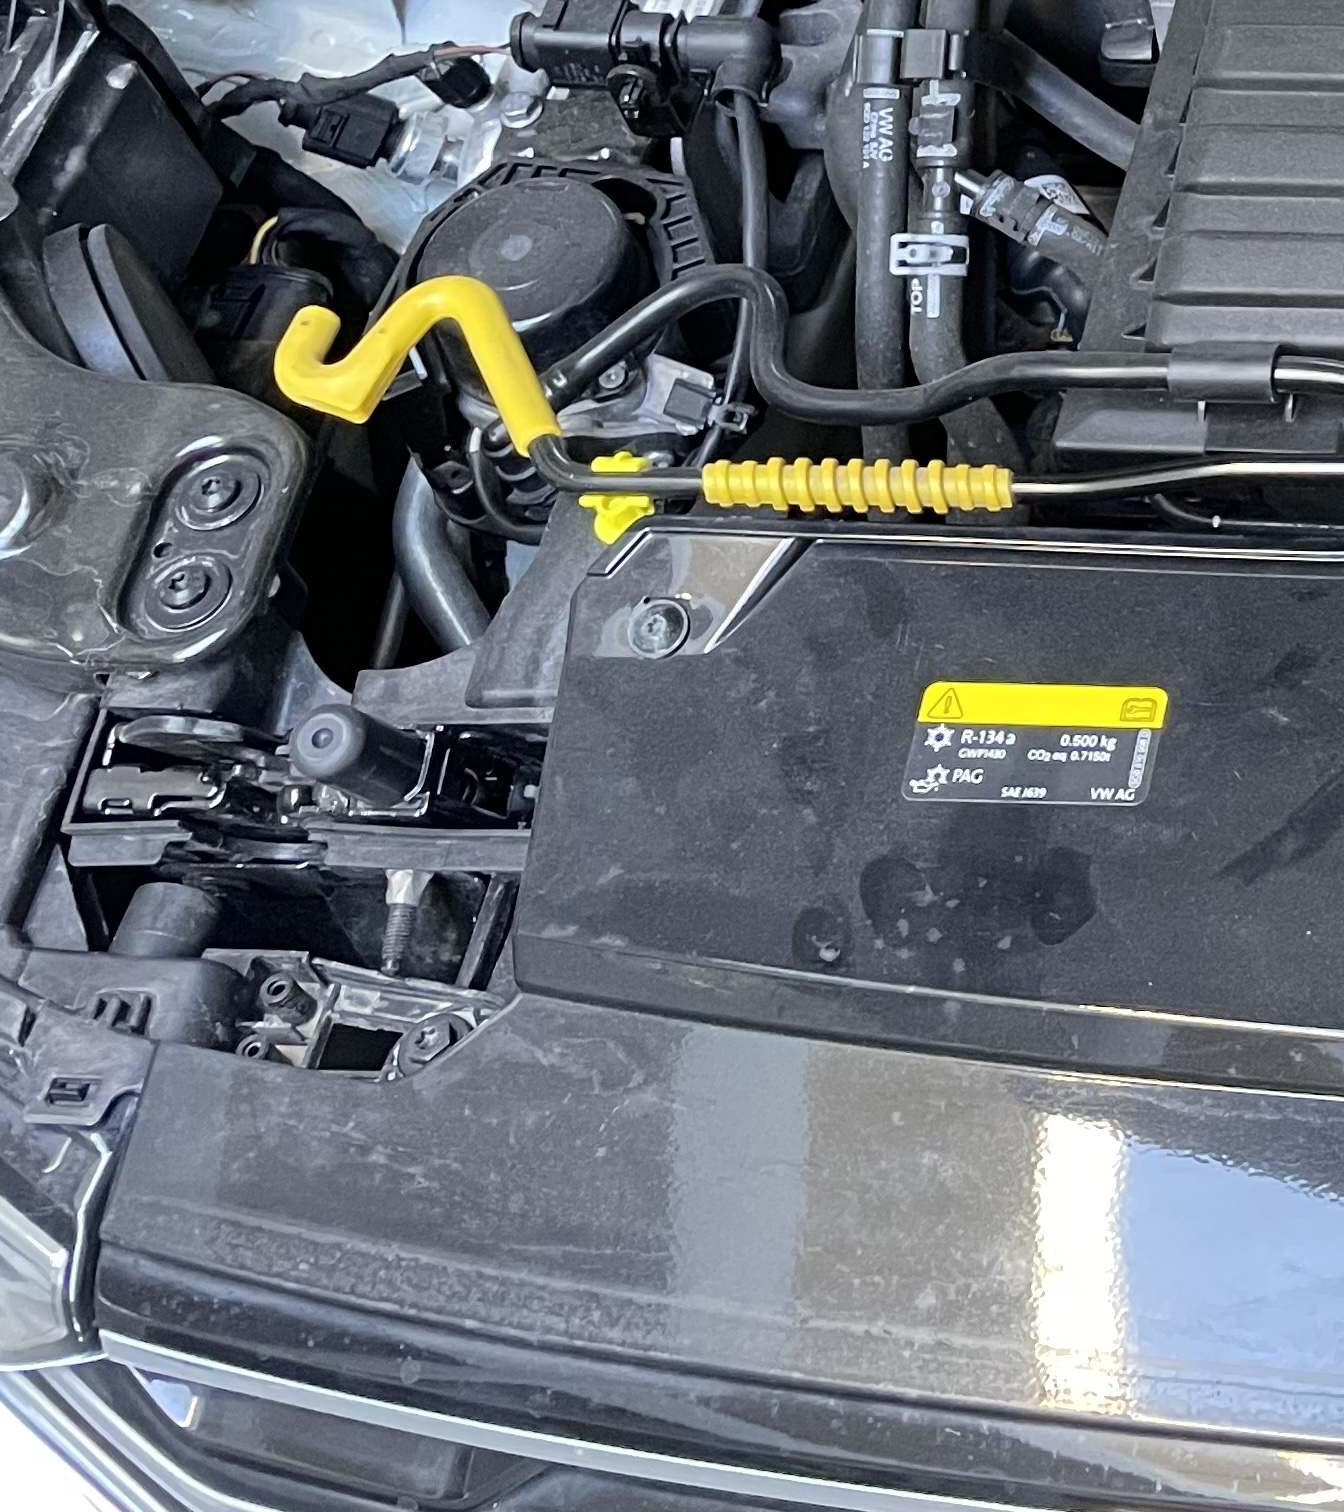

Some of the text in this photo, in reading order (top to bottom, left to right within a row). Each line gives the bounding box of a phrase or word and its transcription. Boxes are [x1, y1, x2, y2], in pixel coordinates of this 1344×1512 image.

[910, 277, 923, 316] TOP
[1060, 734, 1099, 748] 0.500
[1100, 734, 1118, 751] kg
[952, 768, 984, 785] PAG
[1000, 786, 1021, 798] SAE
[1090, 787, 1115, 800] VW
[1114, 788, 1136, 801] AG
